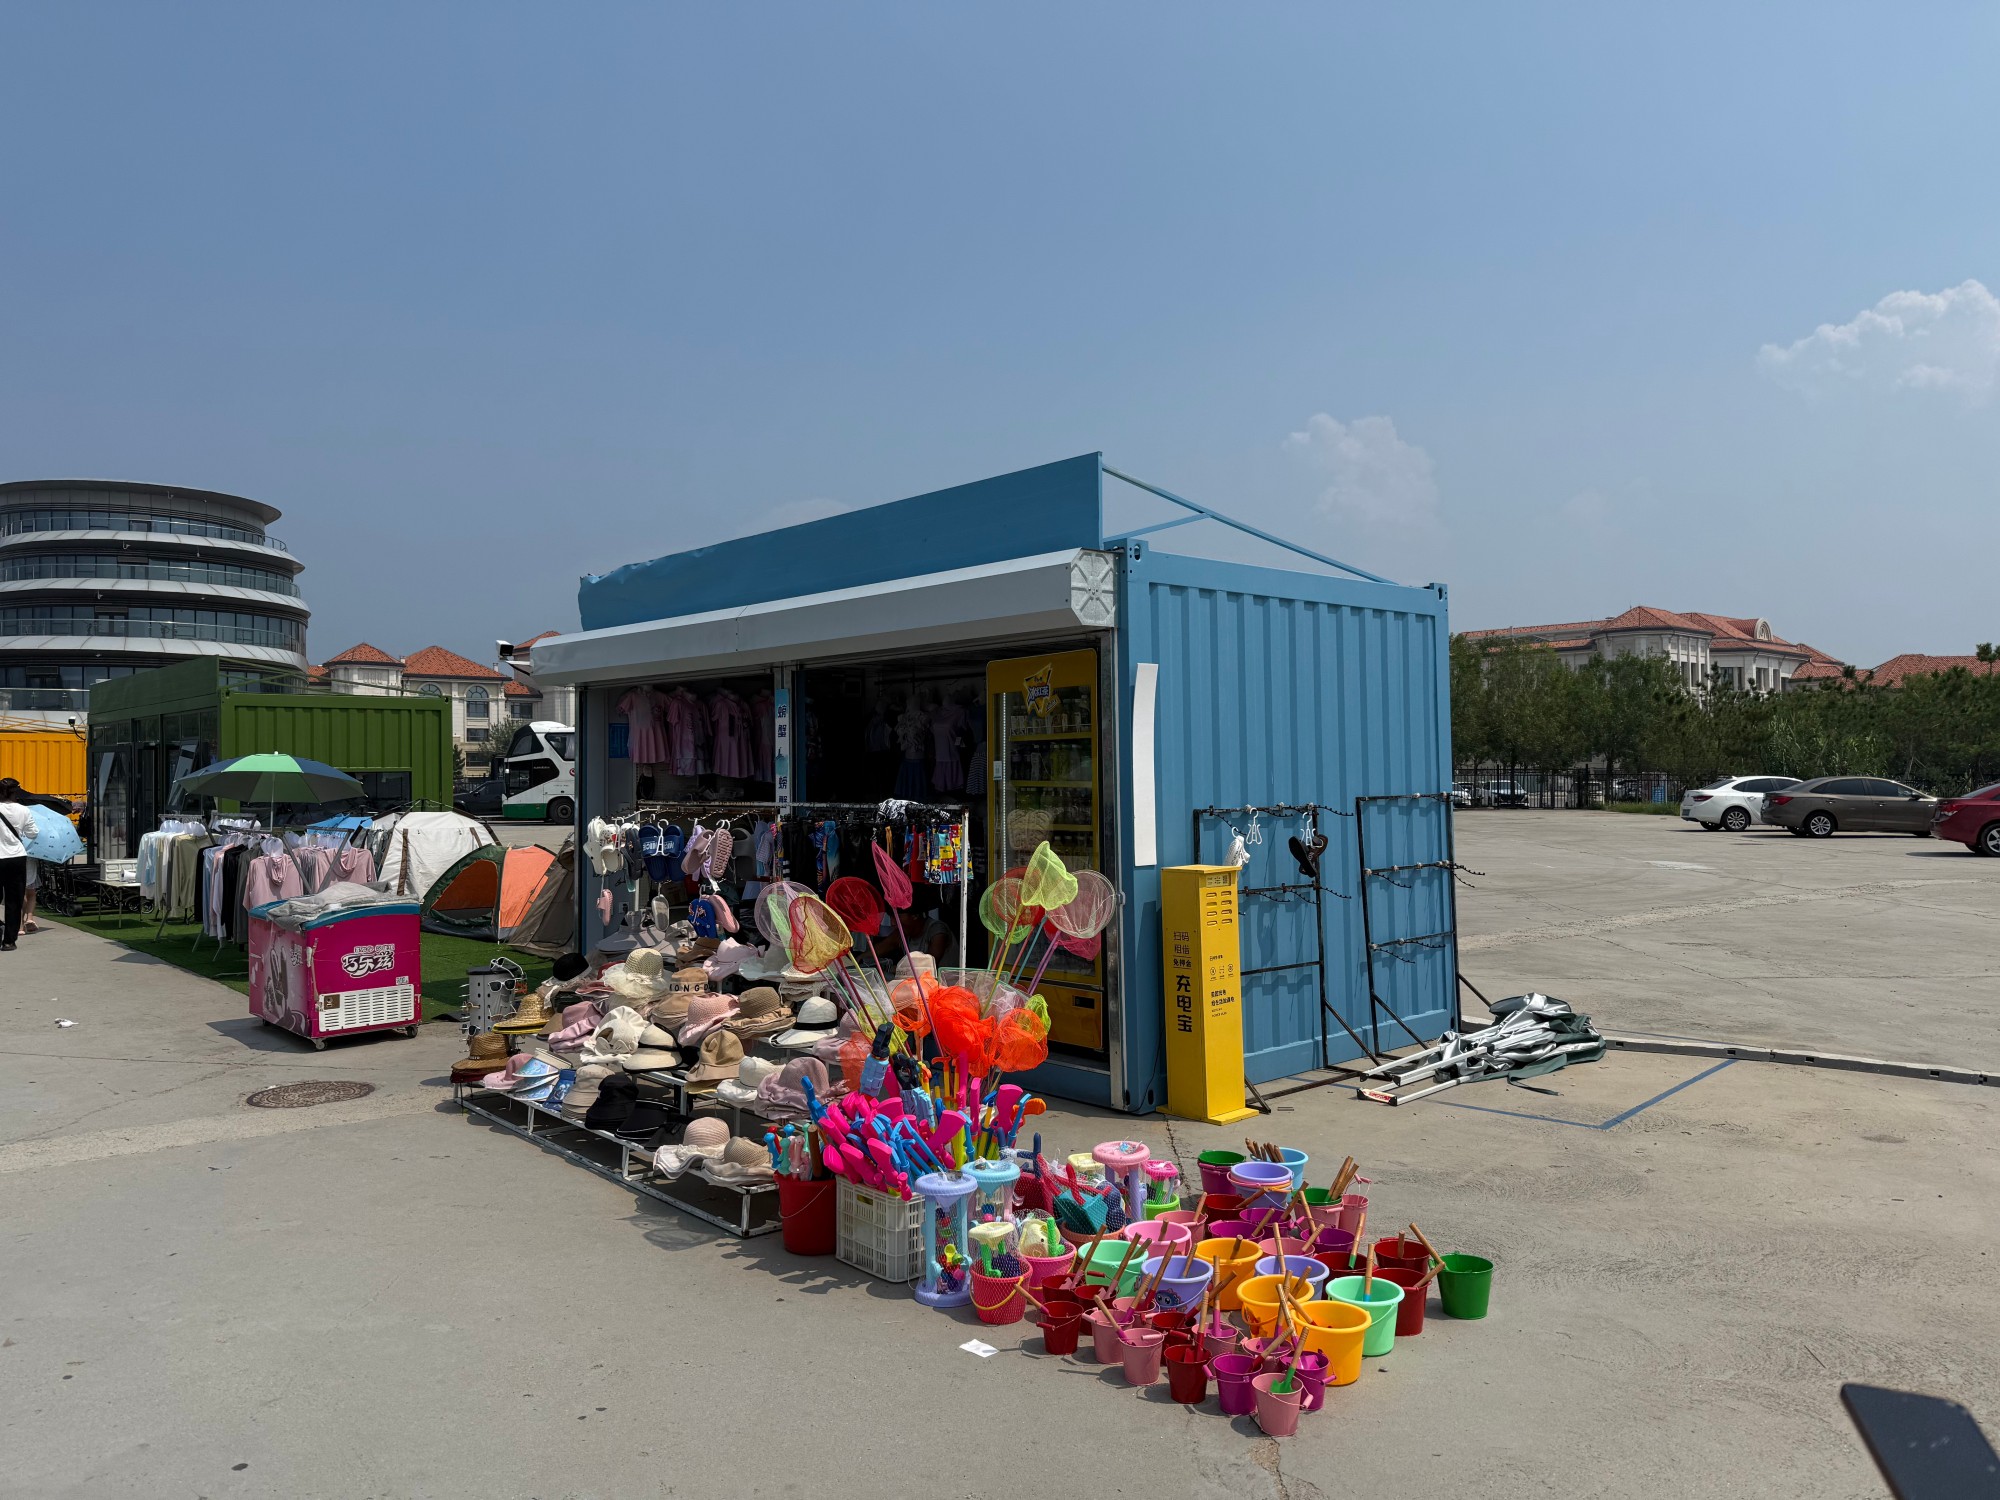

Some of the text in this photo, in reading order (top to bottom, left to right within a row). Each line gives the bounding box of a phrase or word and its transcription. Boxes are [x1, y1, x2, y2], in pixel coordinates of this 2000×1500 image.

[1174, 931, 1190, 942] 扫码
[1175, 944, 1190, 955] 租借
[341, 951, 395, 978] 巧乐兹
[1173, 958, 1192, 968] 免押金
[1176, 974, 1193, 1033] 充电宝
